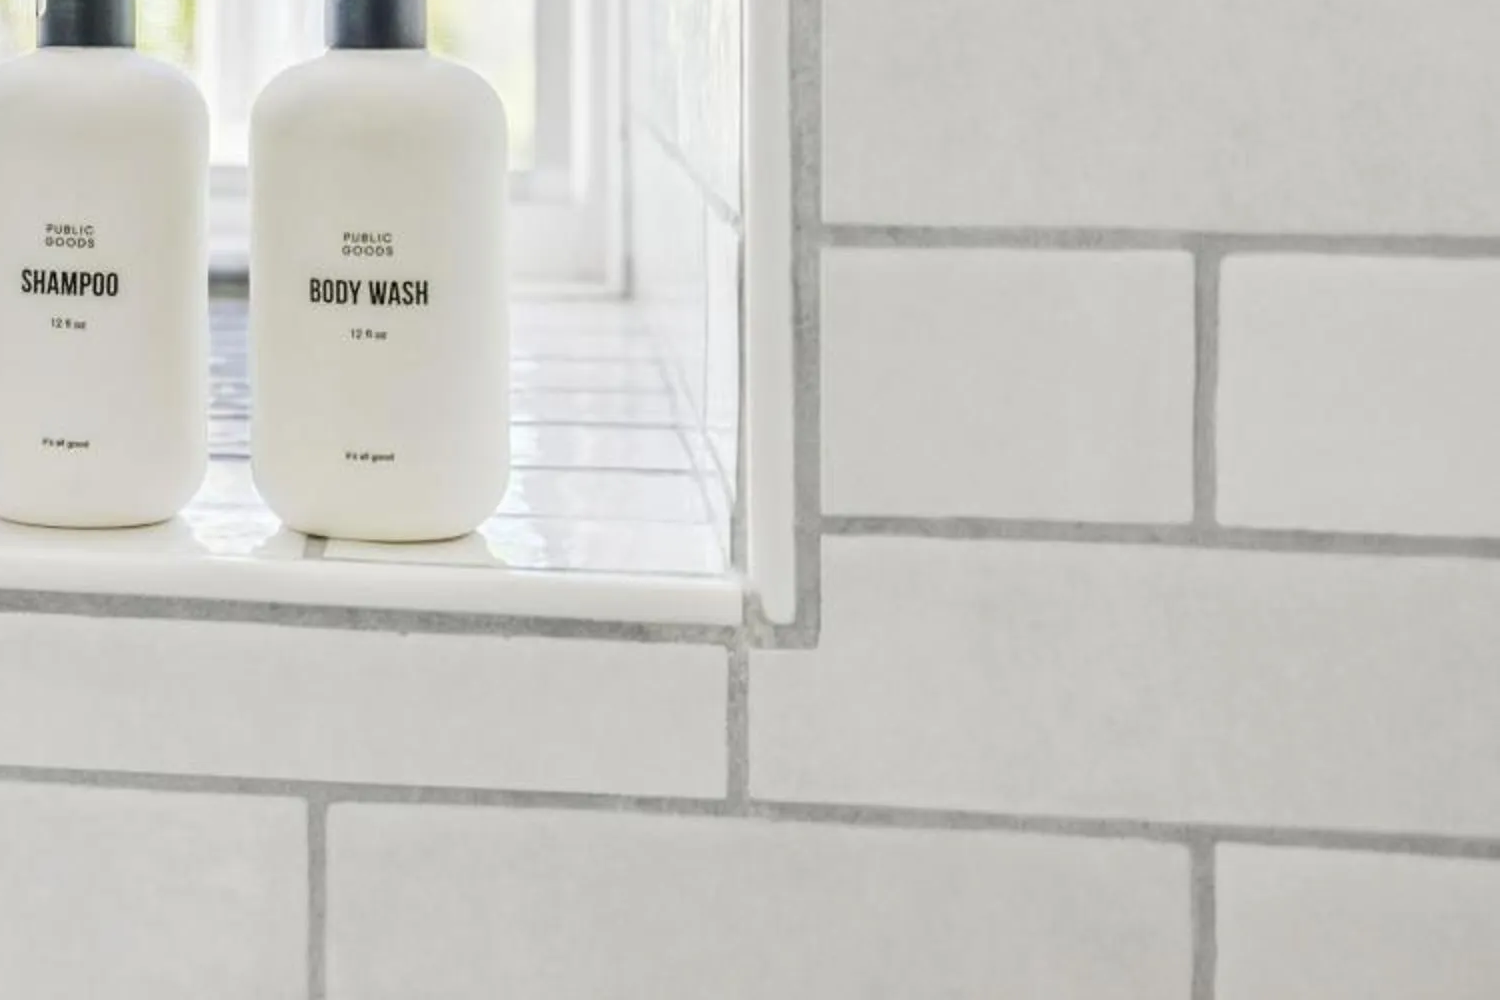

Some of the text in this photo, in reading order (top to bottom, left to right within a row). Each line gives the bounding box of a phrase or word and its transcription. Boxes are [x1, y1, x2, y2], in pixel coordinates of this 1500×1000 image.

[45, 223, 95, 236] PUBLIC
[44, 236, 96, 249] GOODS
[342, 231, 393, 244] PUBLIC
[341, 244, 394, 257] GOODS
[20, 268, 119, 298] SHAMPOO
[309, 277, 429, 306] BODY WASH
[51, 317, 63, 329] 12
[351, 328, 363, 340] 12
